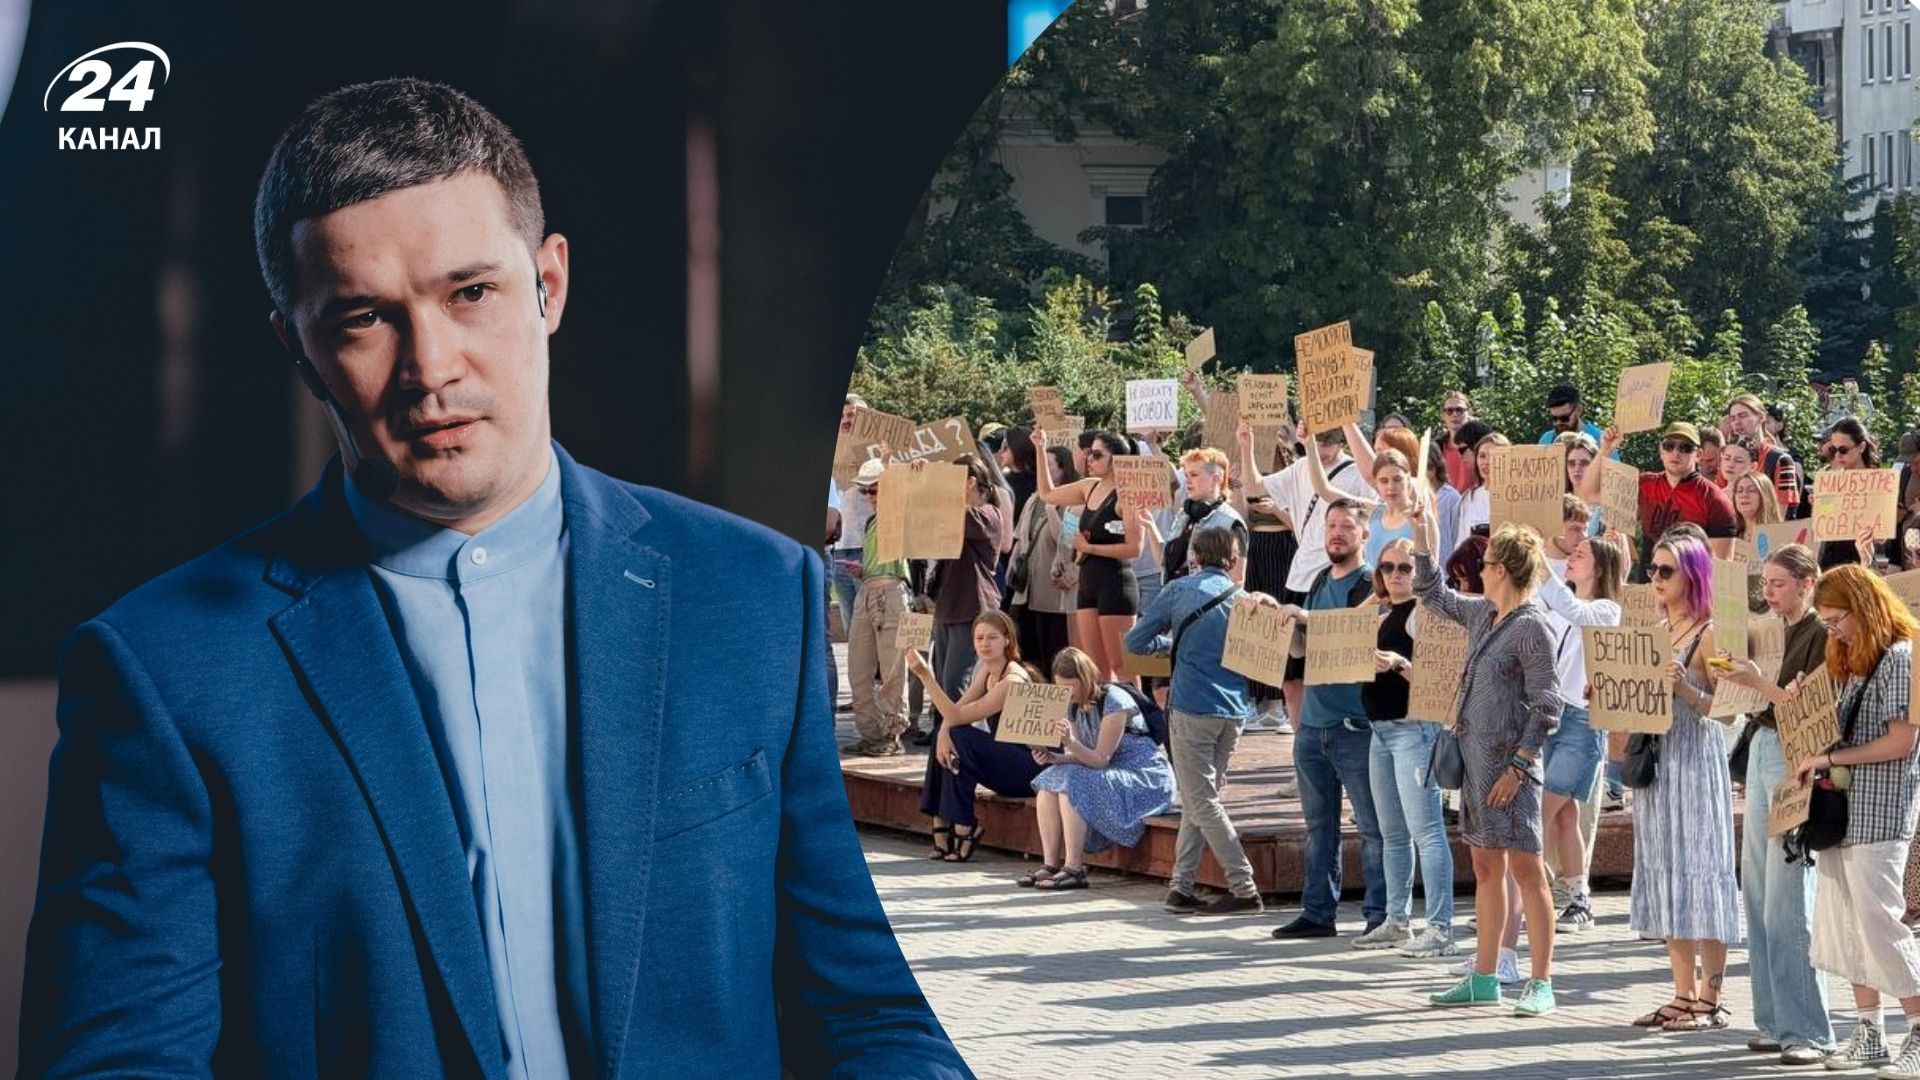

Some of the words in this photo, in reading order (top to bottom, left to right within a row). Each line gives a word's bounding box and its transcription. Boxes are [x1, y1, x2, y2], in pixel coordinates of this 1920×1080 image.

[1593, 630, 1661, 668] ВЕРНІТЬ
[1023, 704, 1044, 719] НЕ
[1593, 671, 1668, 716] ФЕДОРОВА
